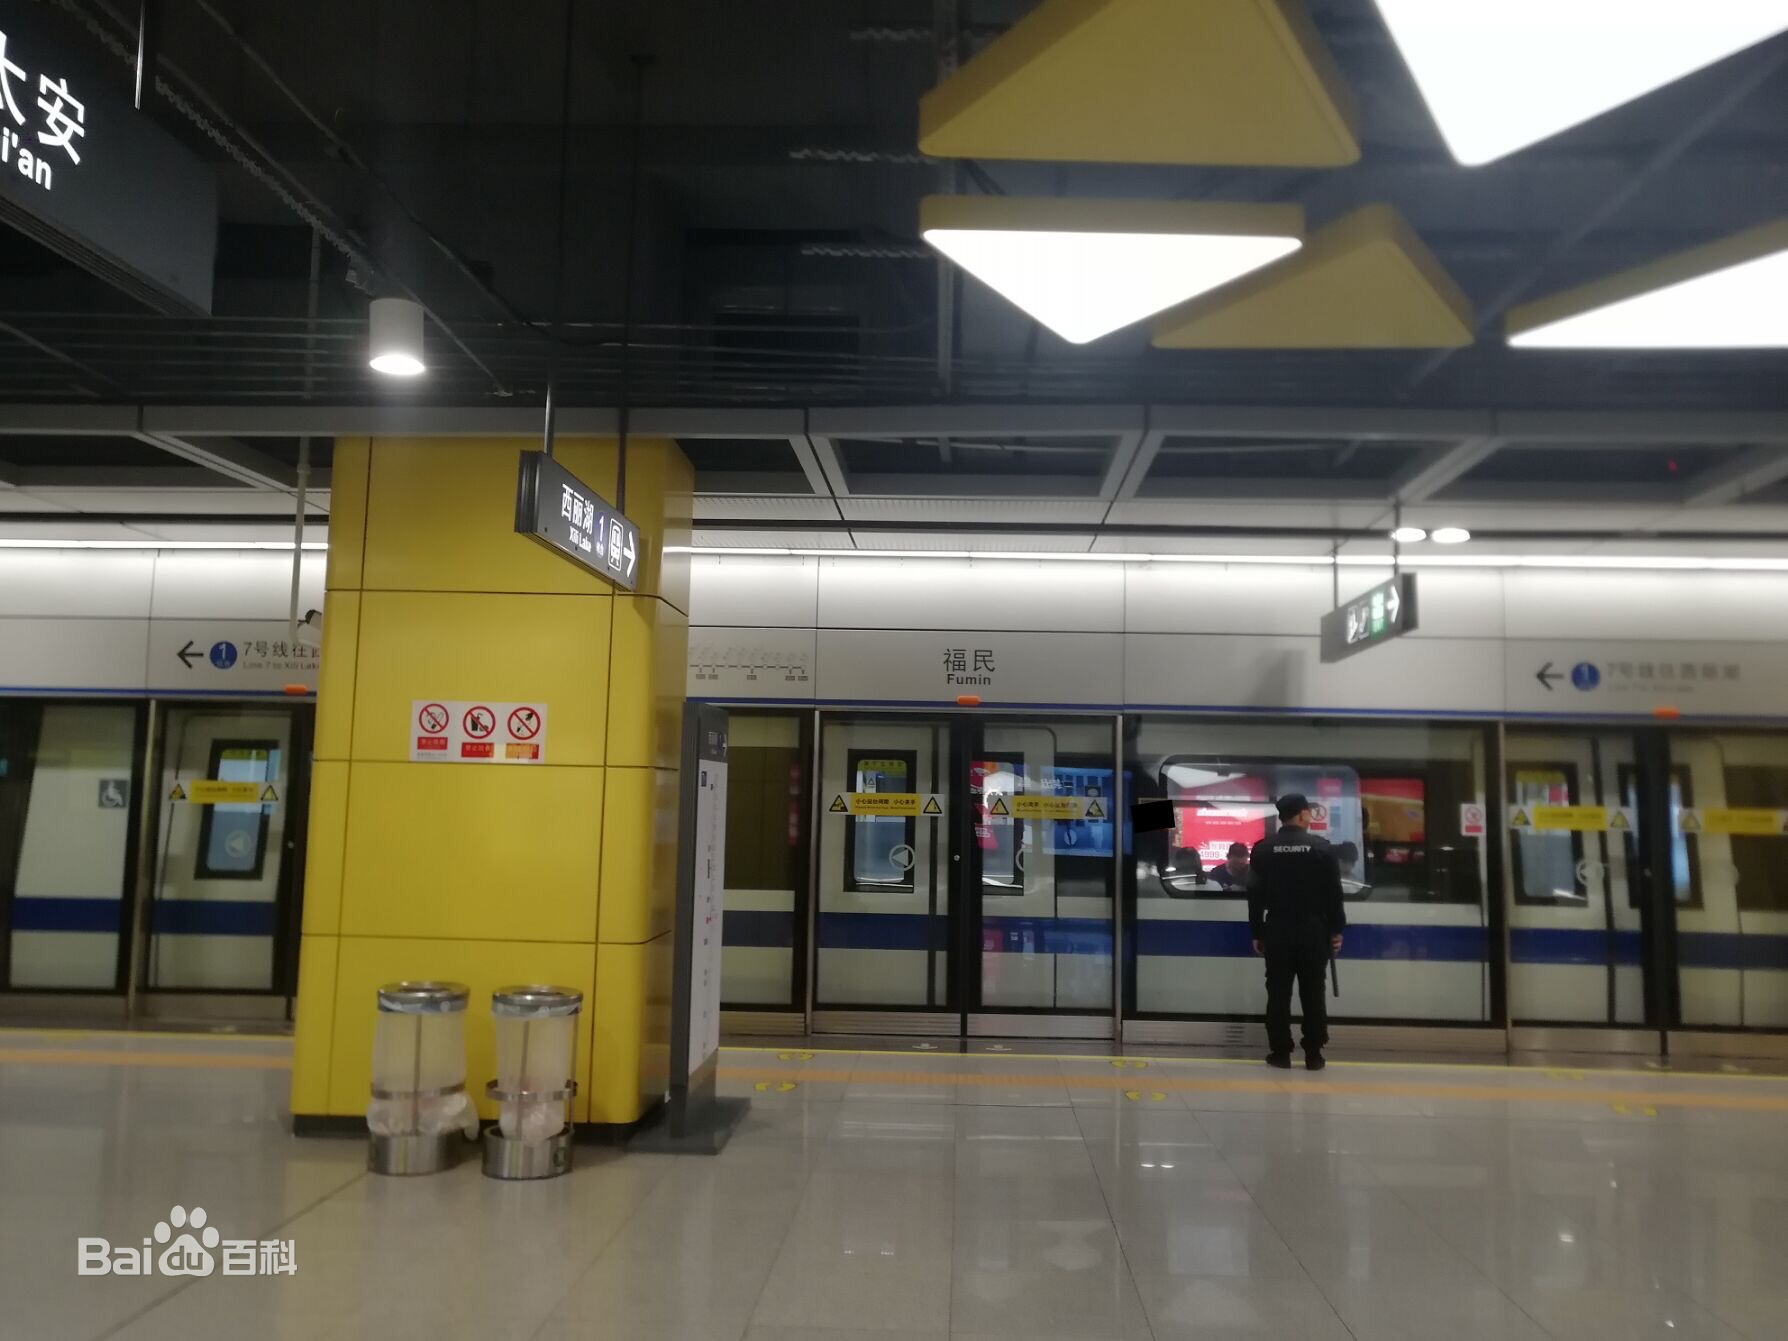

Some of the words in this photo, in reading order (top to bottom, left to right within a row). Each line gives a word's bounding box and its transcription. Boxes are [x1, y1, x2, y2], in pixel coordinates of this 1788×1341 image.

[561, 483, 594, 535] 西丽湖
[943, 648, 996, 672] 福民
[947, 673, 991, 685] Fumin
[1273, 845, 1312, 853] SECURITY
